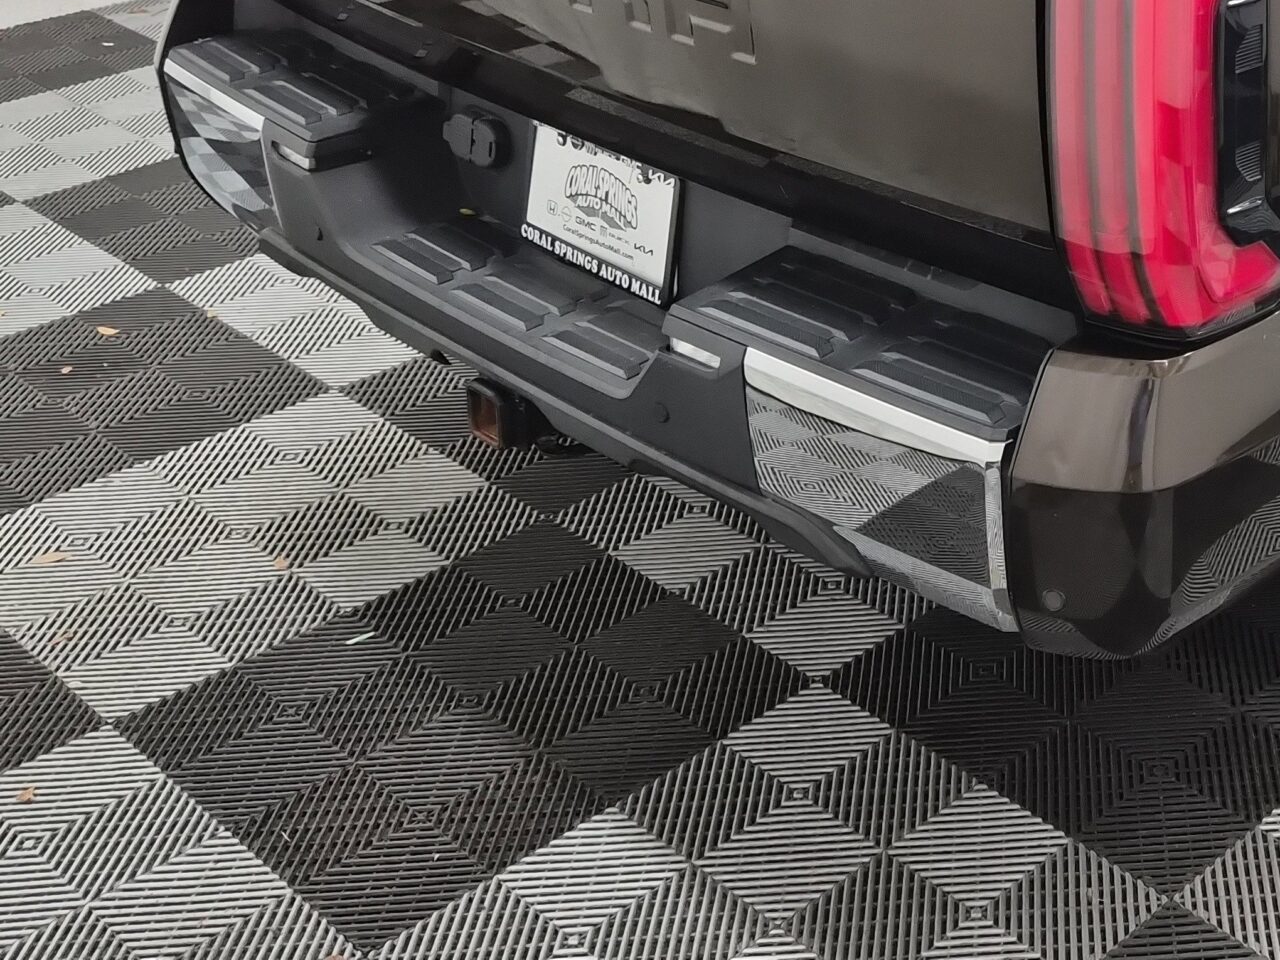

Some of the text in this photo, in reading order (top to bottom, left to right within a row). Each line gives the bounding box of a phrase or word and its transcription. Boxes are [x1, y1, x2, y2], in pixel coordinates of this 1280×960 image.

[565, 164, 639, 230] CORAL SPRINGS
[576, 195, 627, 232] AUTO MALL
[575, 215, 597, 232] GMC
[521, 224, 662, 305] CORAL SPRINGS AUTO MALL
